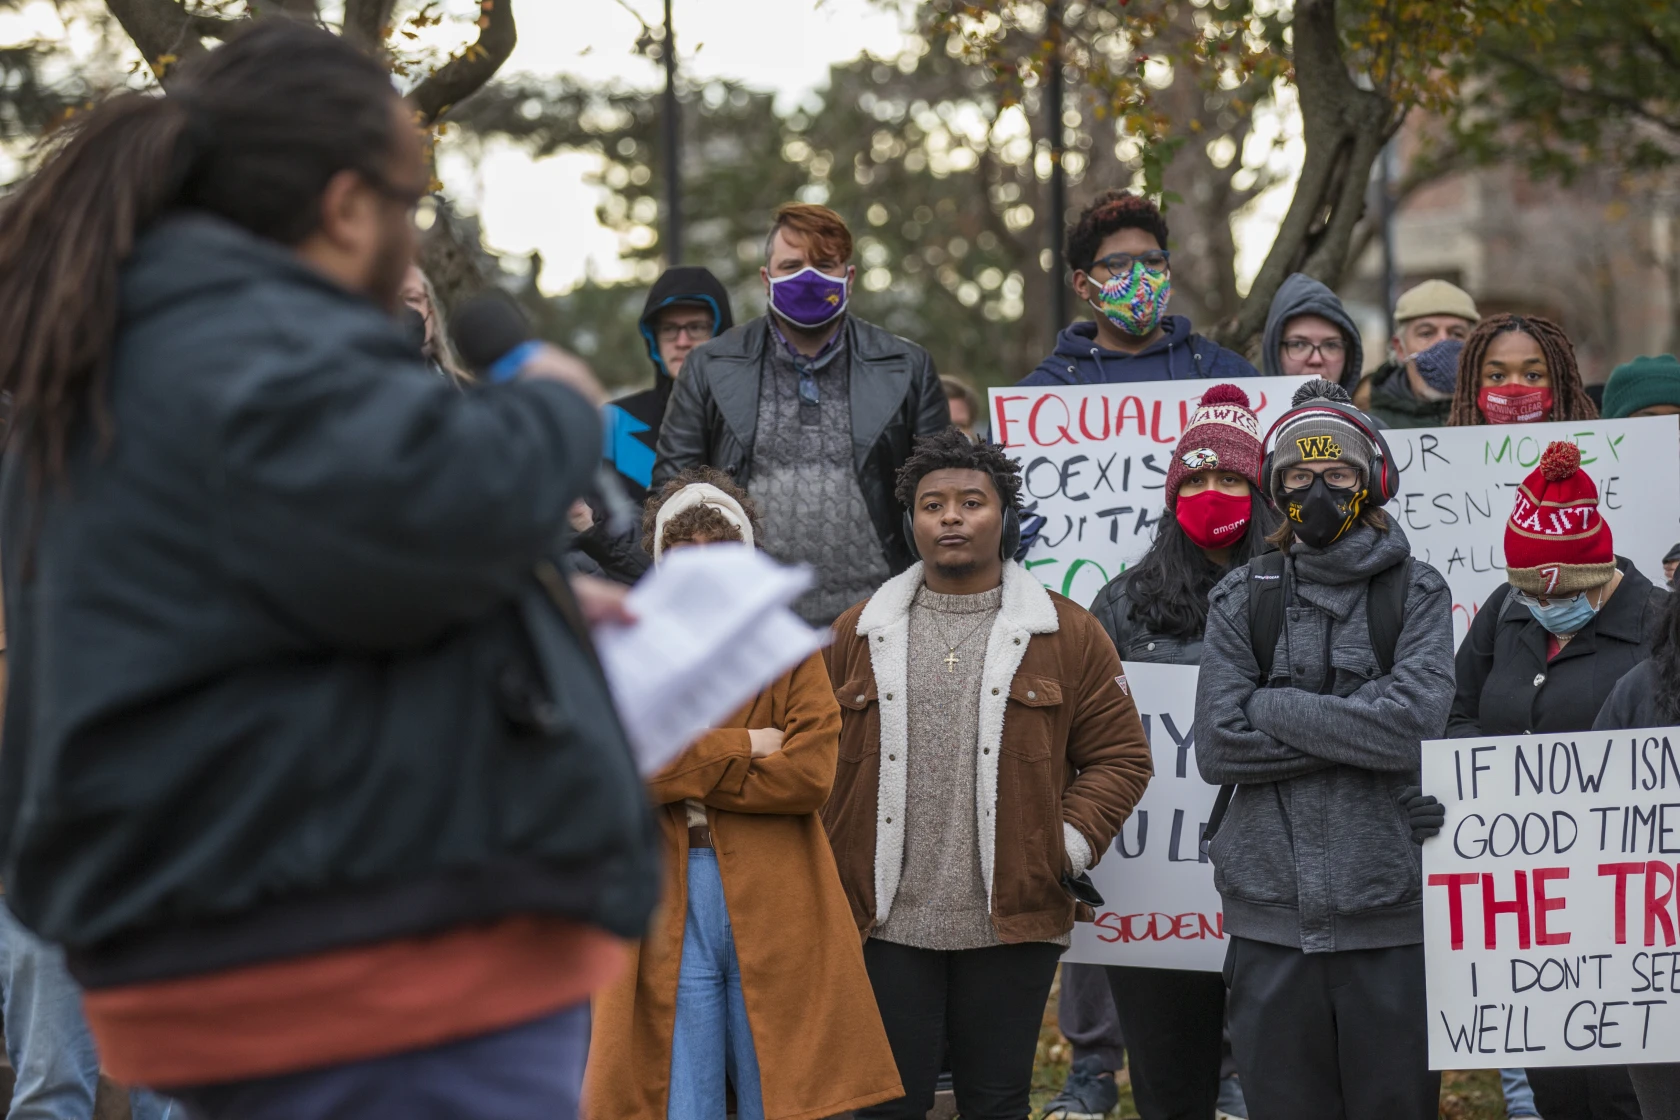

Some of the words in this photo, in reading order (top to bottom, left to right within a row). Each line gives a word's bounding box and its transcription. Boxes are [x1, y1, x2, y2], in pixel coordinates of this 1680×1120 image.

[994, 391, 1267, 448] EQUALI
[1012, 451, 1176, 502] OEXIS
[1397, 434, 1451, 472] UR
[1484, 432, 1626, 468] MOEY
[1388, 480, 1524, 530] ESN'
[1540, 566, 1560, 595] 7
[1455, 745, 1497, 801] IF
[1515, 739, 1613, 797] NOW
[1453, 811, 1578, 860] GOOD
[1590, 804, 1680, 854] TIME
[1093, 911, 1225, 943] STUDEN
[1428, 866, 1572, 951] THE
[1598, 860, 1680, 947] TR
[1471, 962, 1478, 998] I
[1510, 953, 1613, 993] DON'T
[1440, 1002, 1546, 1055] WE'LL
[1563, 999, 1668, 1052] GET
